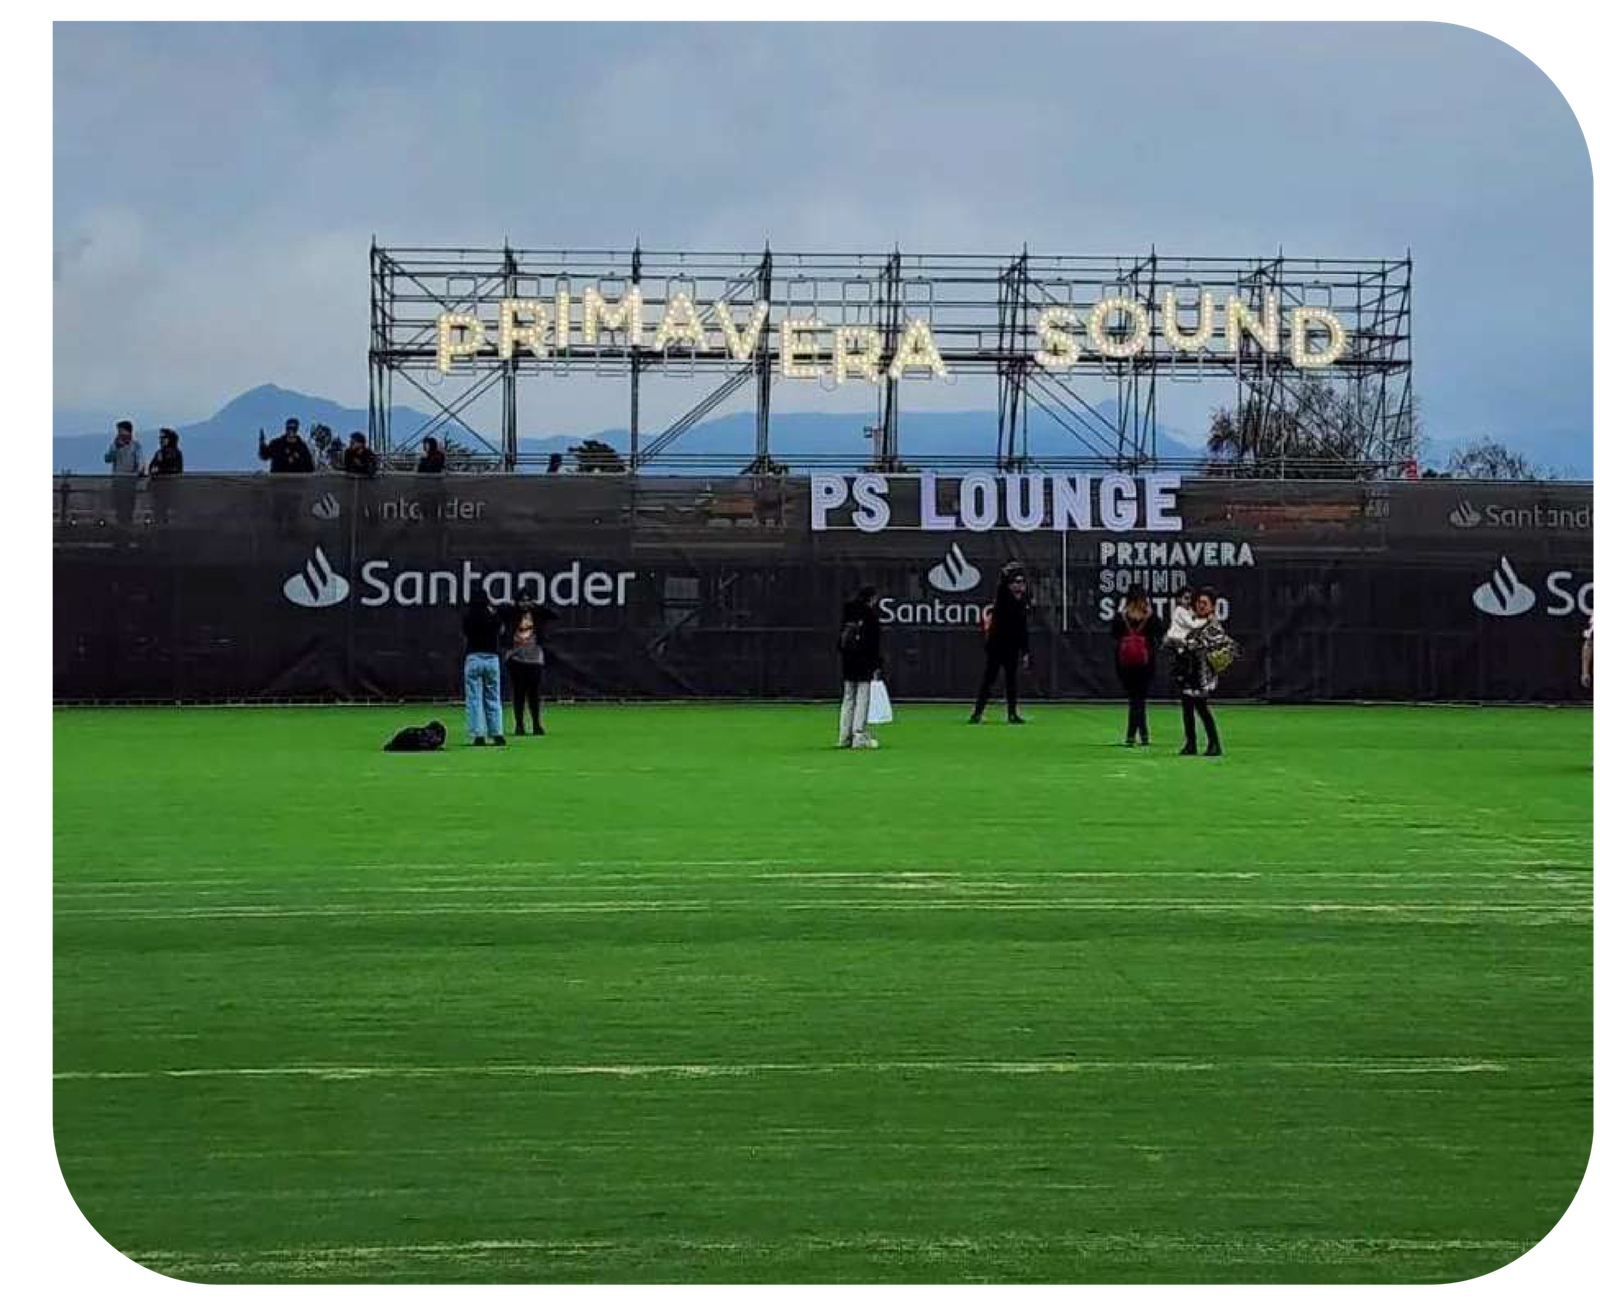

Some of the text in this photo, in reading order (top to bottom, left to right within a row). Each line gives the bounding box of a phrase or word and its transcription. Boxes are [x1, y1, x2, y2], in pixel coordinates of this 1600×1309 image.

[436, 285, 1347, 384] PRIMAVERA SOUND
[811, 471, 1183, 532] PS LOUNGE
[1485, 504, 1594, 528] Santand
[1100, 541, 1255, 567] PRIMAVERA
[361, 560, 635, 605] Santander
